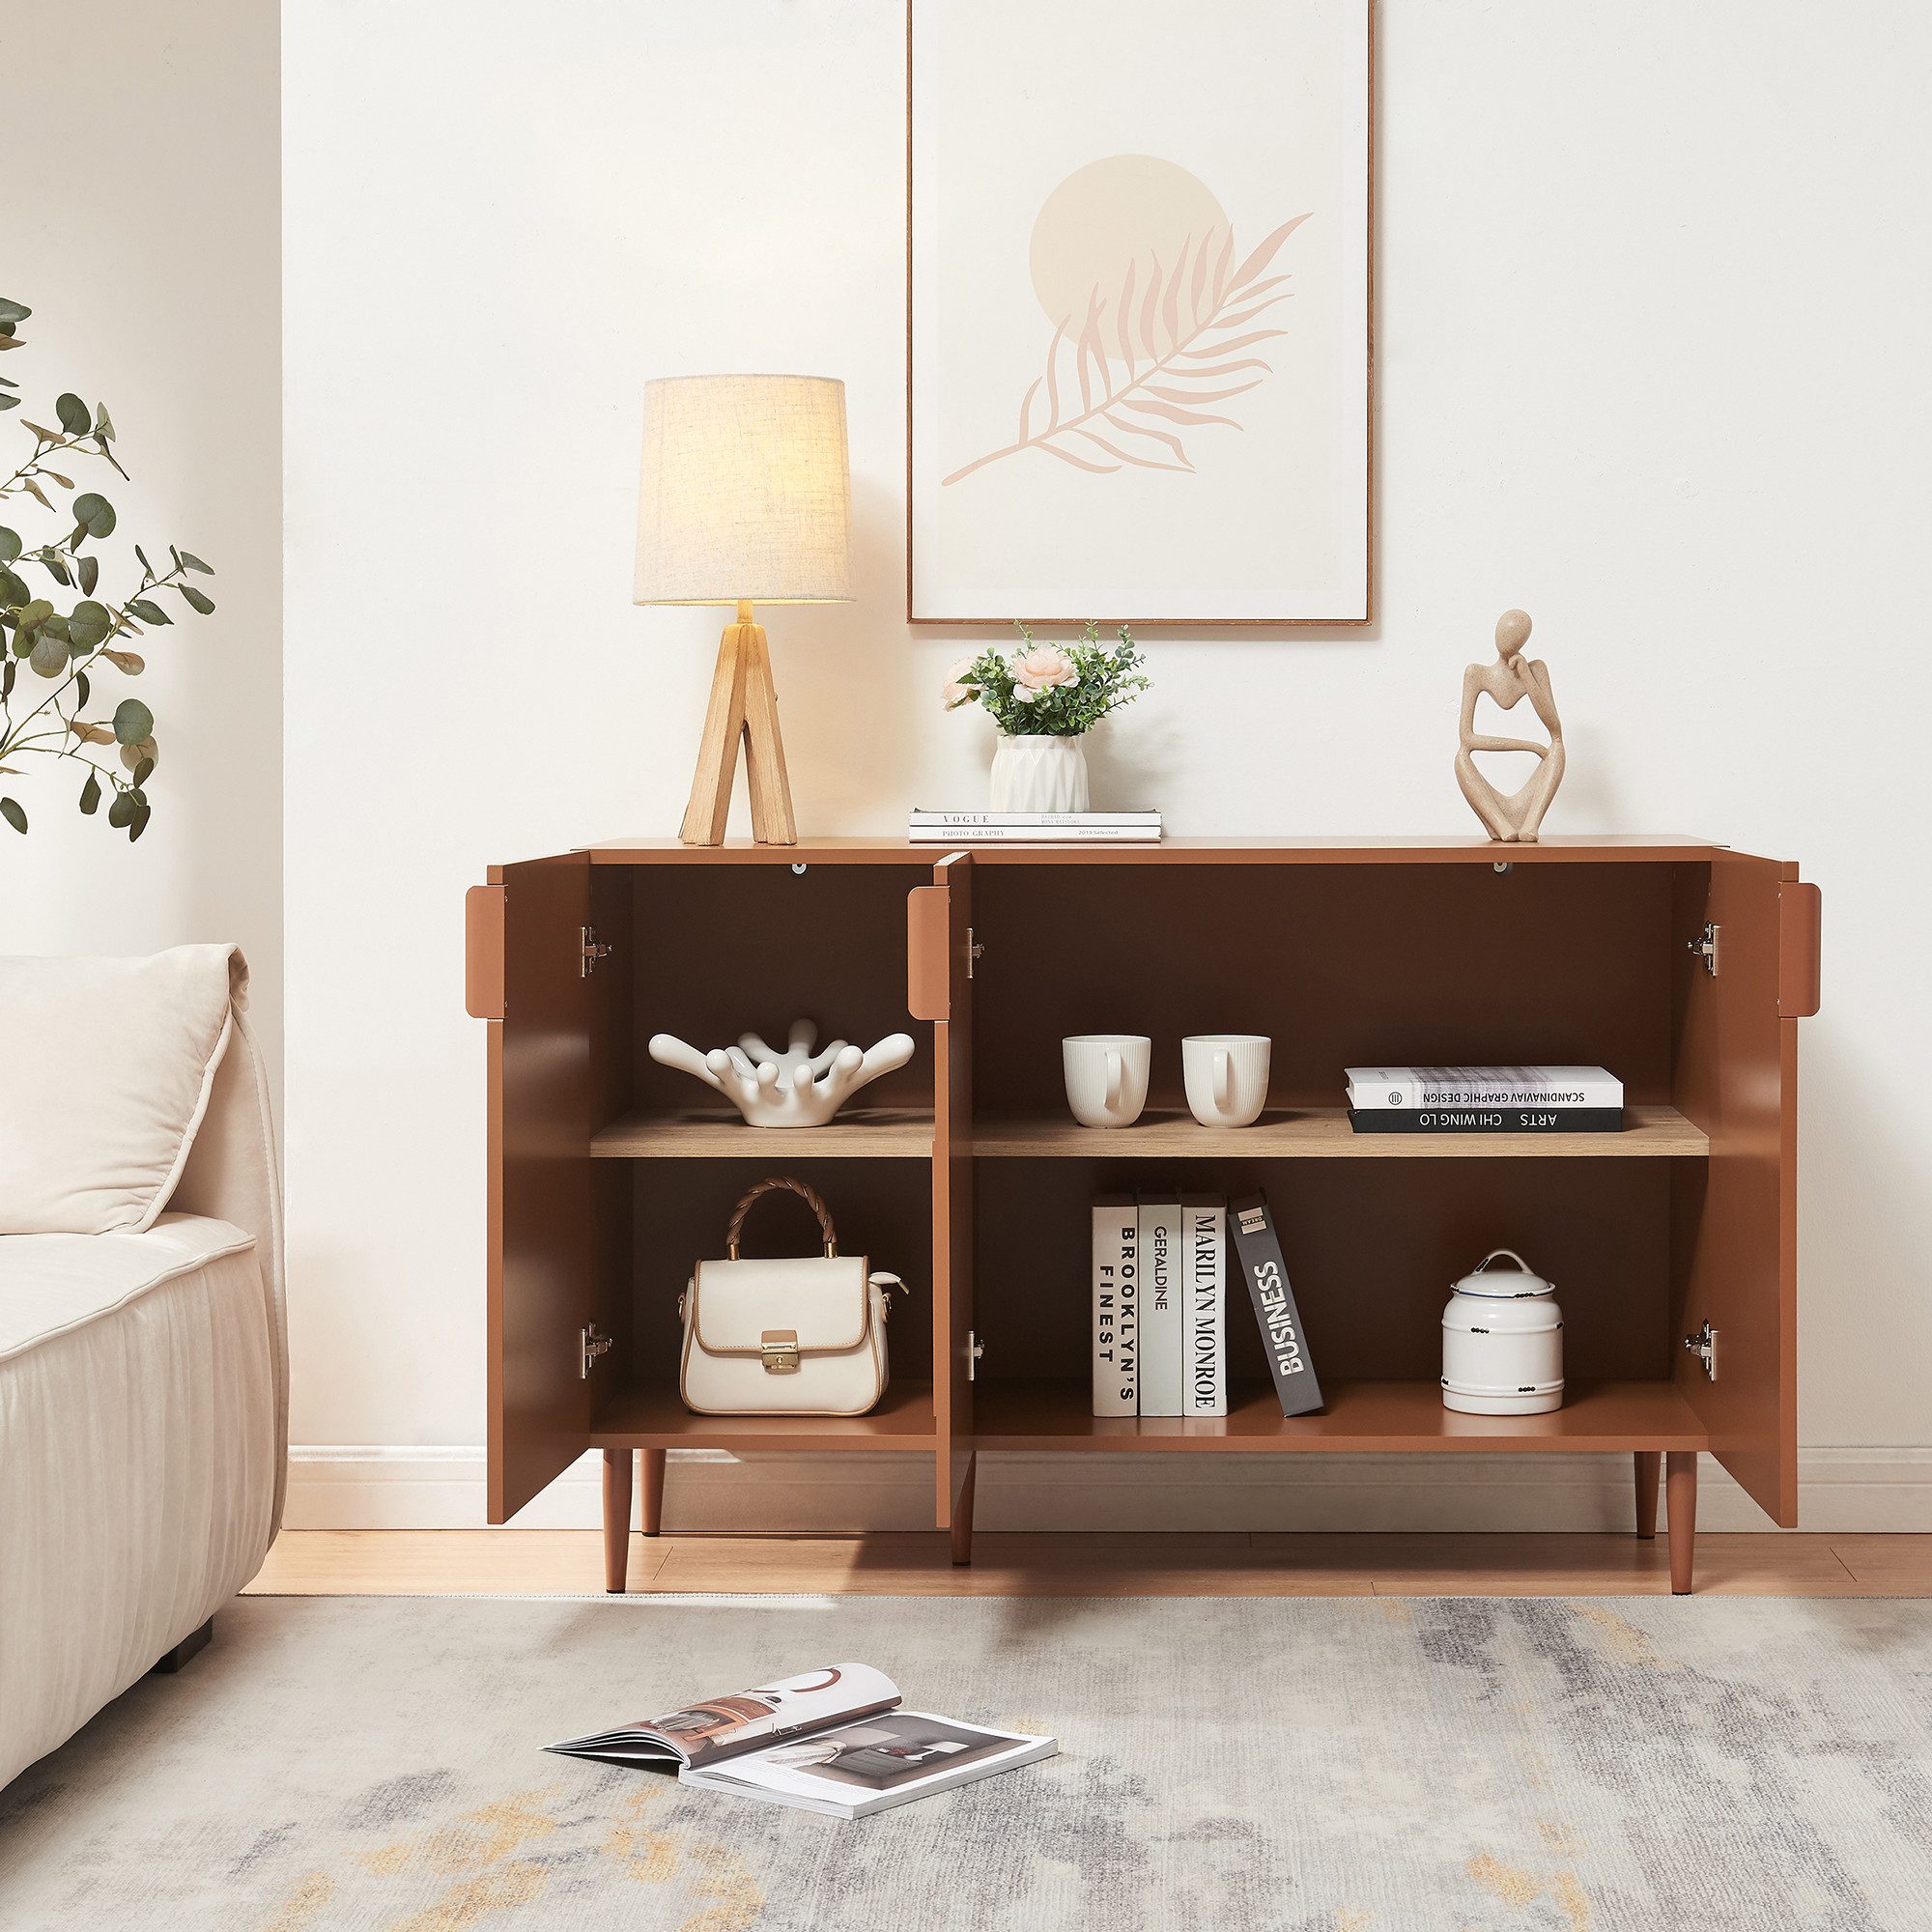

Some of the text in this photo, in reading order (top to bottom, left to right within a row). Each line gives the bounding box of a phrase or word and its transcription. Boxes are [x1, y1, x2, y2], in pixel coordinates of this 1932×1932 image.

[943, 814, 989, 823] VOGUE
[1419, 1113, 1557, 1126] ARTS CHI WING LO
[1423, 1093, 1585, 1103] SCANDINAVIAV GRAPHIC DESIGN
[1153, 1225, 1168, 1311] GERALDINE
[1194, 1214, 1216, 1408] MARILYN MONROE
[1098, 1265, 1114, 1362] FINEST
[1254, 1261, 1304, 1377] BUSINESS
